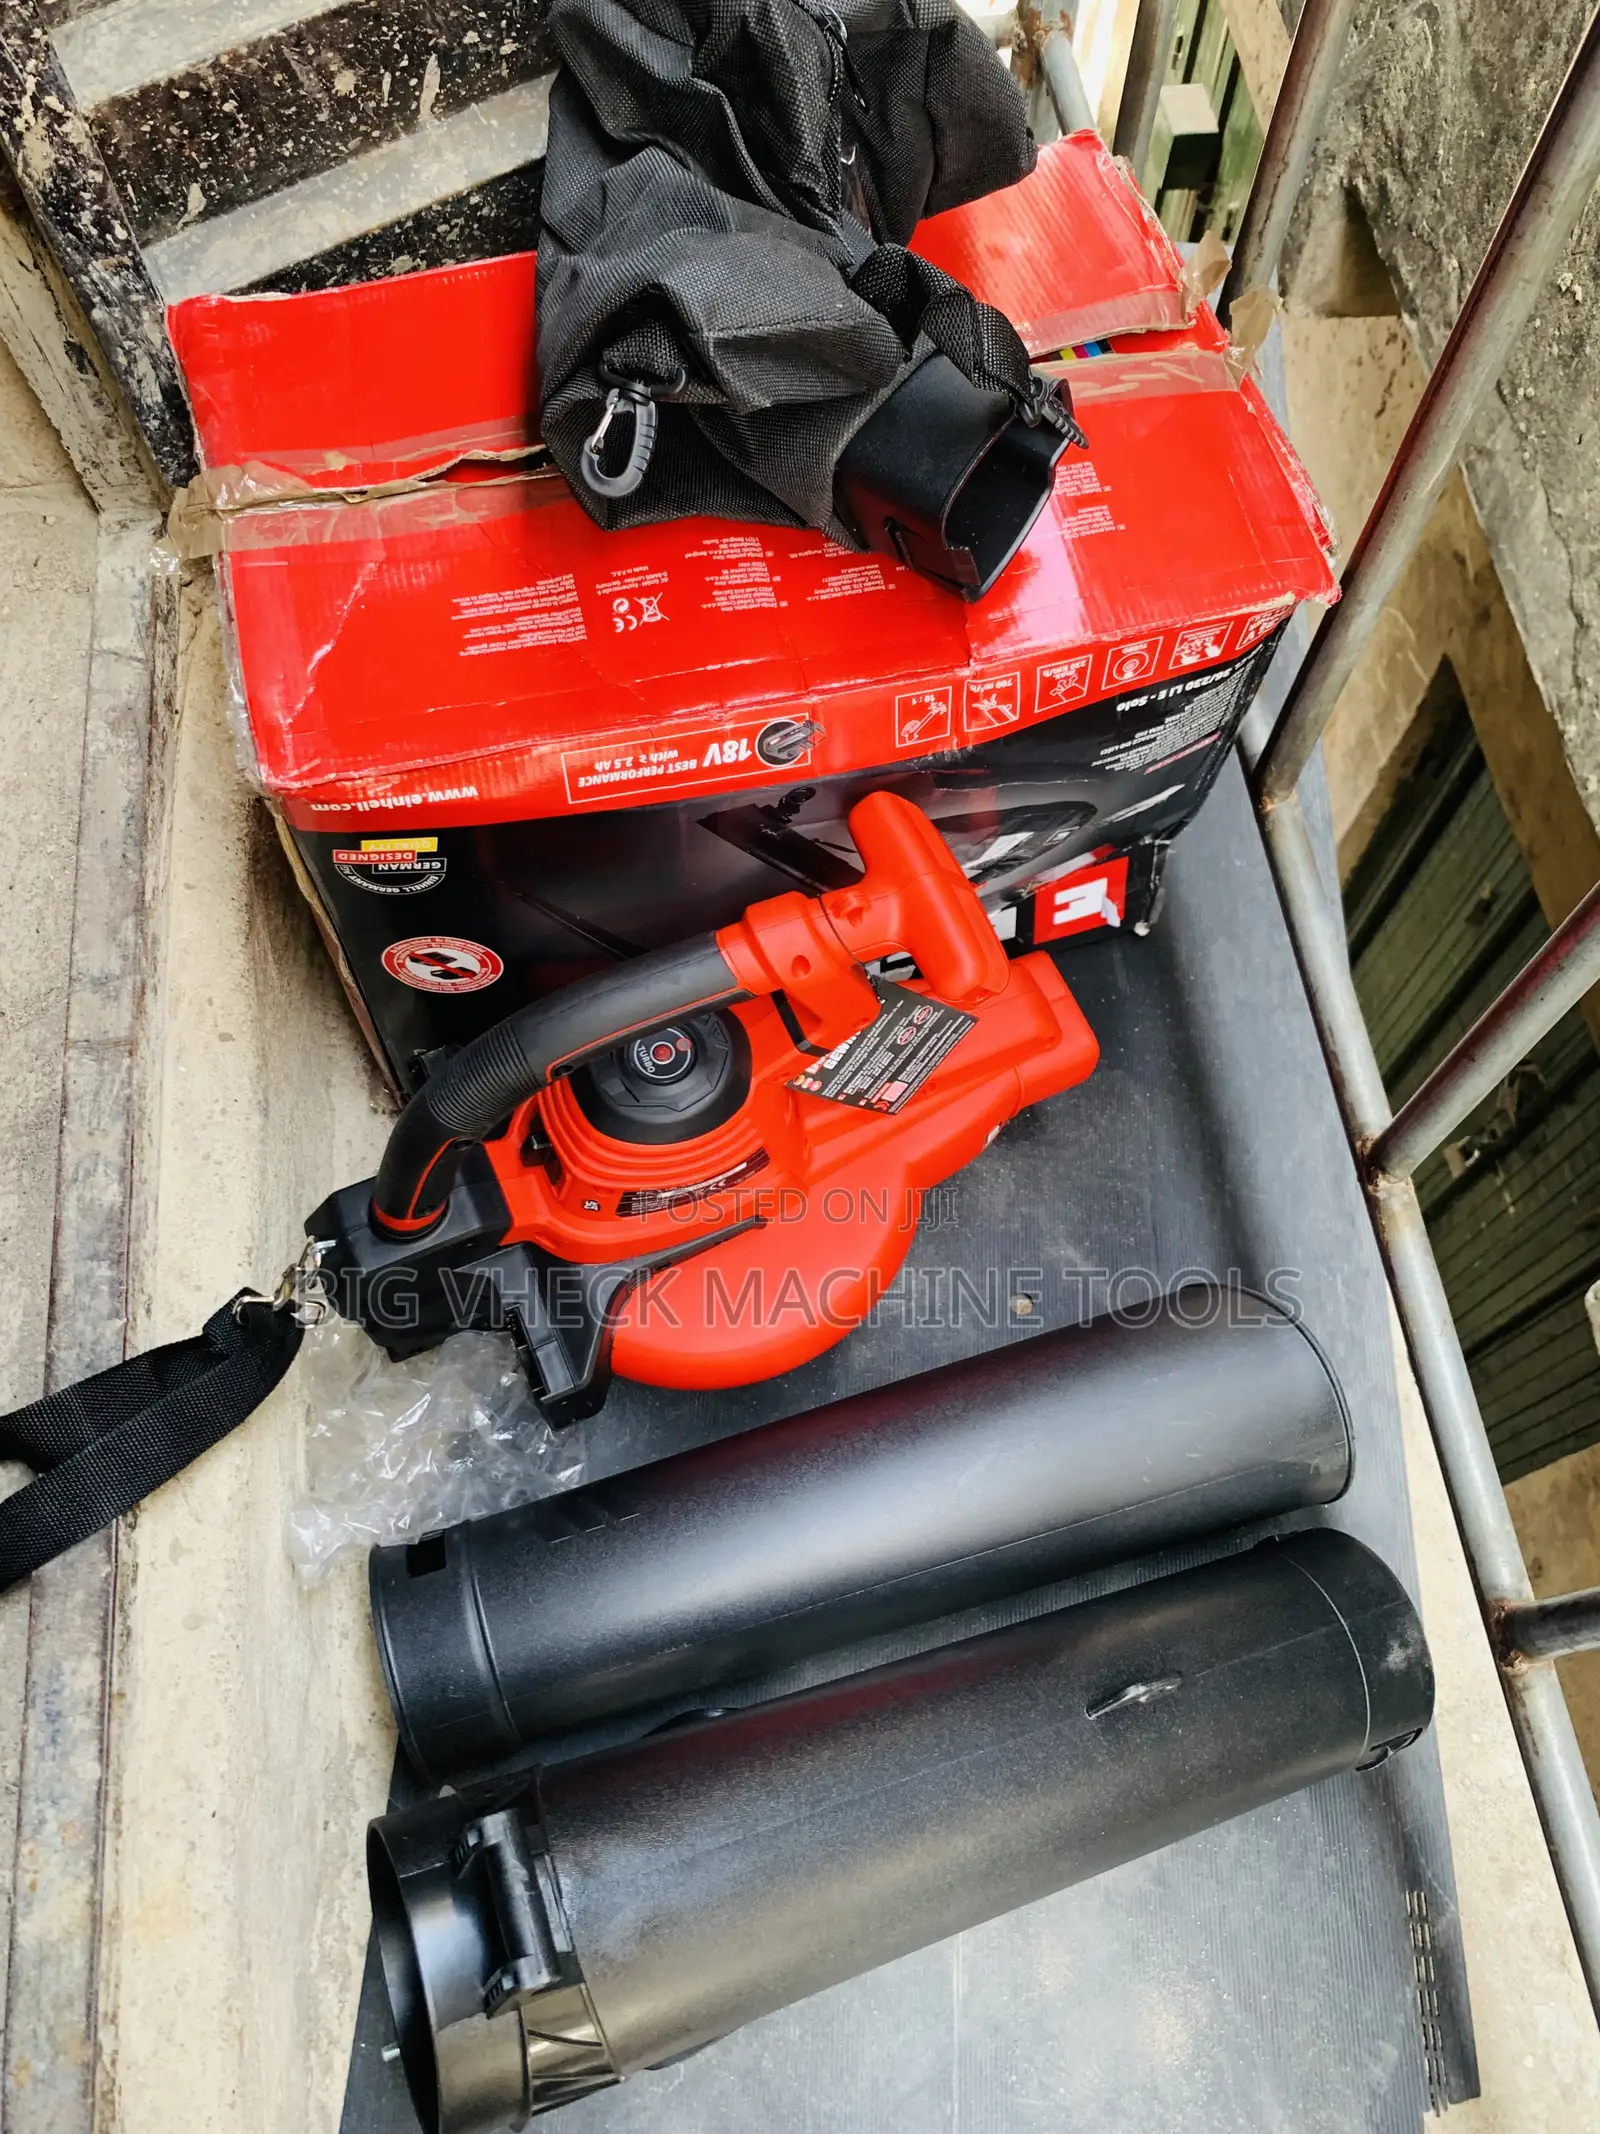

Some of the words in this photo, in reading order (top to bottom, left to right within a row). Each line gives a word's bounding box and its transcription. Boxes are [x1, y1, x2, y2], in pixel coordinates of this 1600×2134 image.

[1116, 695, 1148, 711] Solo
[649, 749, 678, 763] with
[703, 738, 751, 766] 18V
[594, 759, 611, 771] Ah
[613, 756, 633, 768] 2.5
[667, 759, 697, 773] BEST
[578, 765, 663, 786] PERFORMANCE
[311, 786, 478, 814] www.einhell.com
[368, 839, 431, 850] QUALITY
[337, 851, 413, 860] DESIGNED
[377, 861, 441, 870] GERMAN
[347, 874, 400, 893] GERMANY
[402, 874, 438, 892] EINHELL
[636, 1044, 655, 1074] TURBO
